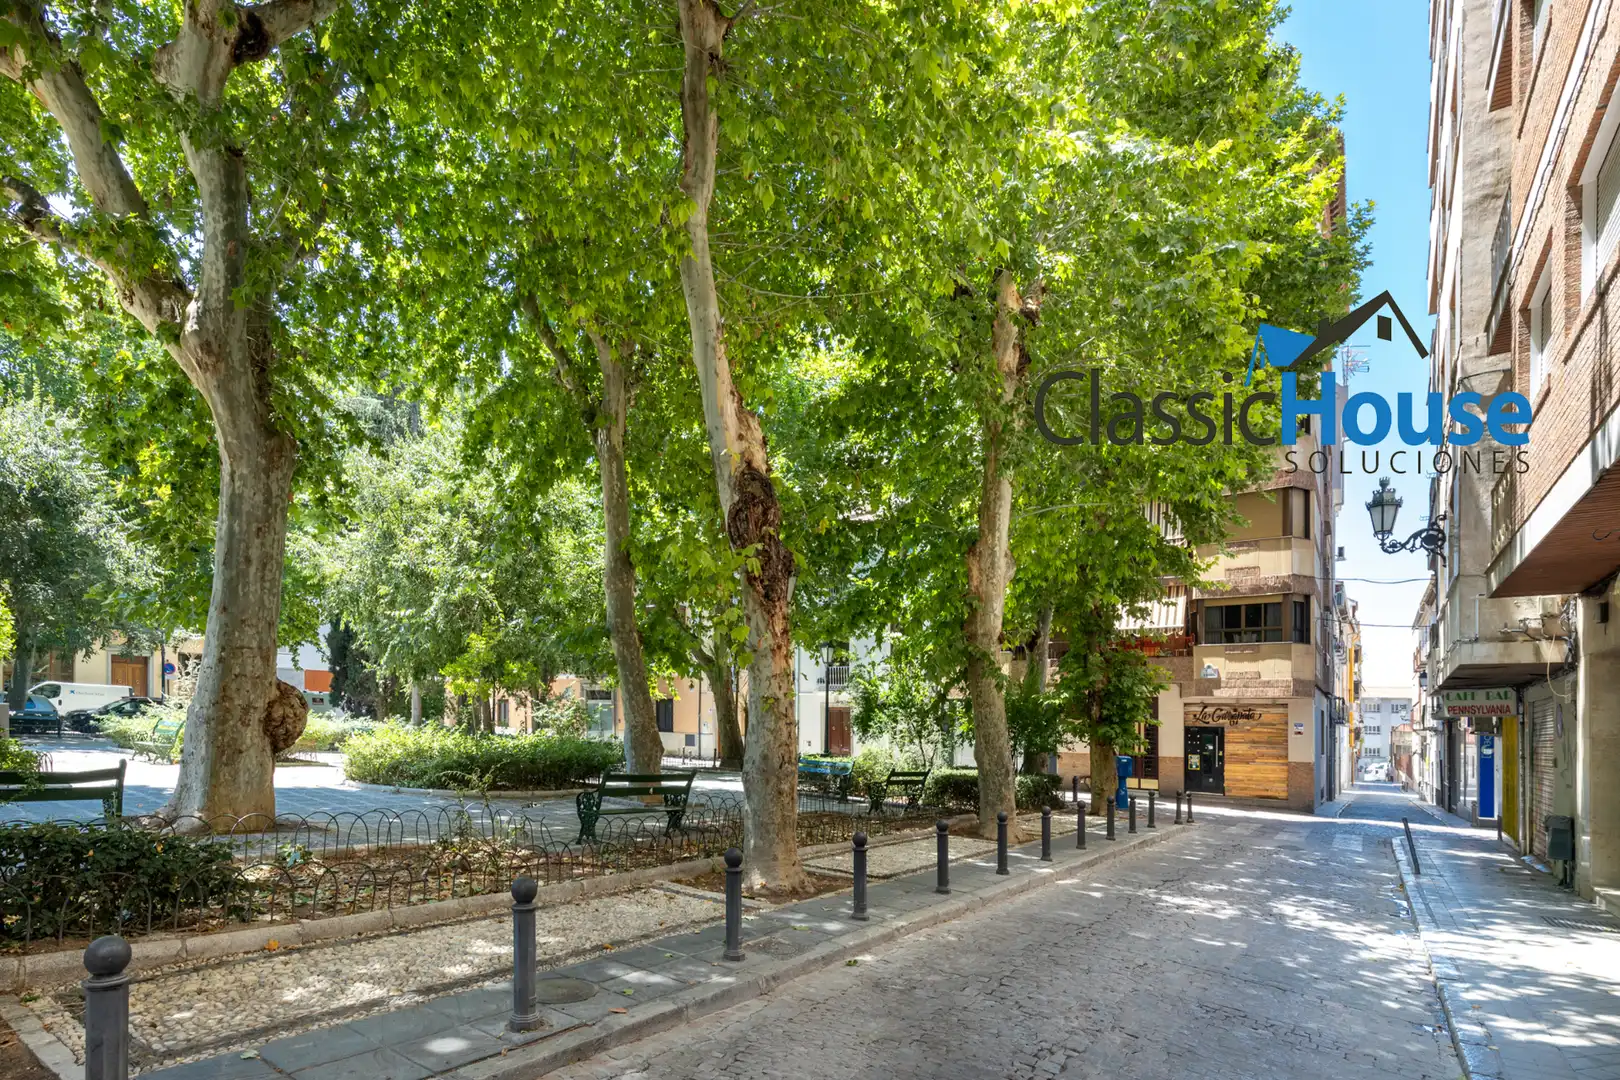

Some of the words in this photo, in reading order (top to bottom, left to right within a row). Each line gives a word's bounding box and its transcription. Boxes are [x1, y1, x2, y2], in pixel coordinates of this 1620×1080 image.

[1486, 690, 1512, 700] BAR
[1193, 702, 1212, 724] La
[1447, 704, 1511, 715] PENNSYLVANIA
